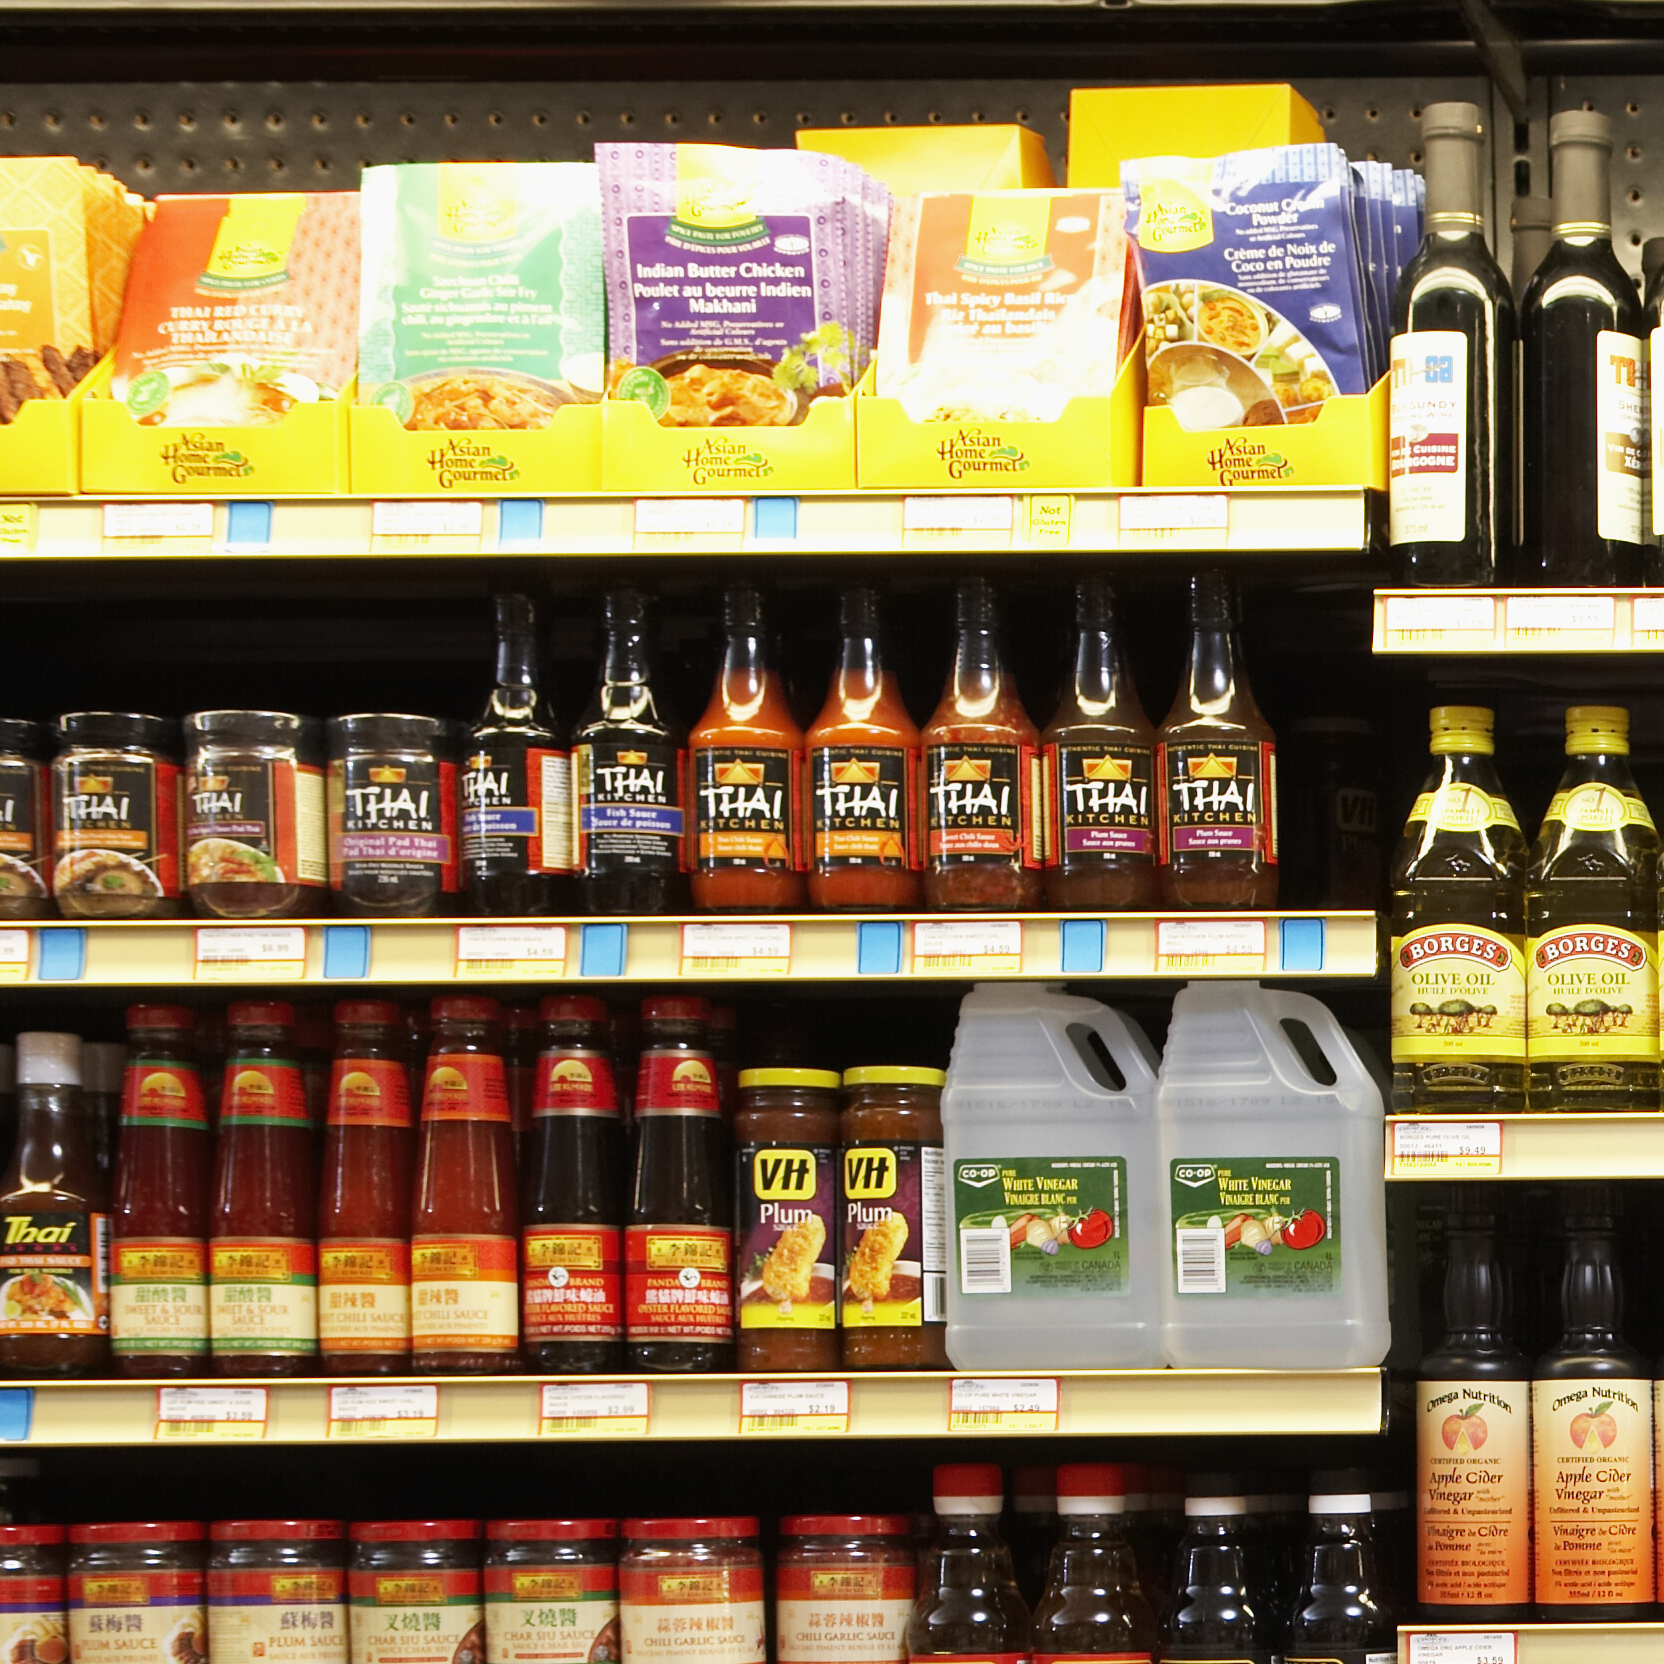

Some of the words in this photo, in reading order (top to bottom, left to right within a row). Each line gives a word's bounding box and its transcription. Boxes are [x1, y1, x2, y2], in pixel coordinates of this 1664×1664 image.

[179, 433, 226, 455] Asian
[160, 443, 211, 467] Home
[171, 460, 246, 486] Gourmet
[1039, 505, 1061, 516] Not
[1031, 518, 1067, 527] Gluten
[1039, 528, 1062, 537] Free
[346, 785, 430, 824] THAI
[347, 820, 433, 830] KITCHEN
[262, 942, 290, 953] $6.99
[526, 948, 554, 957] $4.59
[752, 947, 779, 956] $4.59
[1410, 936, 1497, 959] BORGES
[1412, 973, 1461, 986] OLIVE
[1466, 973, 1495, 985] OIL
[1417, 986, 1447, 996] HUILE
[1450, 986, 1488, 996] D'OLIVE
[1459, 1146, 1486, 1155] $9.49
[1003, 1177, 1035, 1191] WHITE
[1037, 1177, 1078, 1191] VINEGAR
[760, 1203, 814, 1223] Plum
[6, 1215, 76, 1245] Thai
[808, 1403, 836, 1413] $2.19
[1013, 1403, 1041, 1413] $2.49
[1429, 1467, 1463, 1485] Apple
[1466, 1466, 1503, 1485] Cider
[1428, 1487, 1473, 1506] Vinegar
[368, 1634, 394, 1645] CHAR
[420, 1634, 461, 1646] SAUCE
